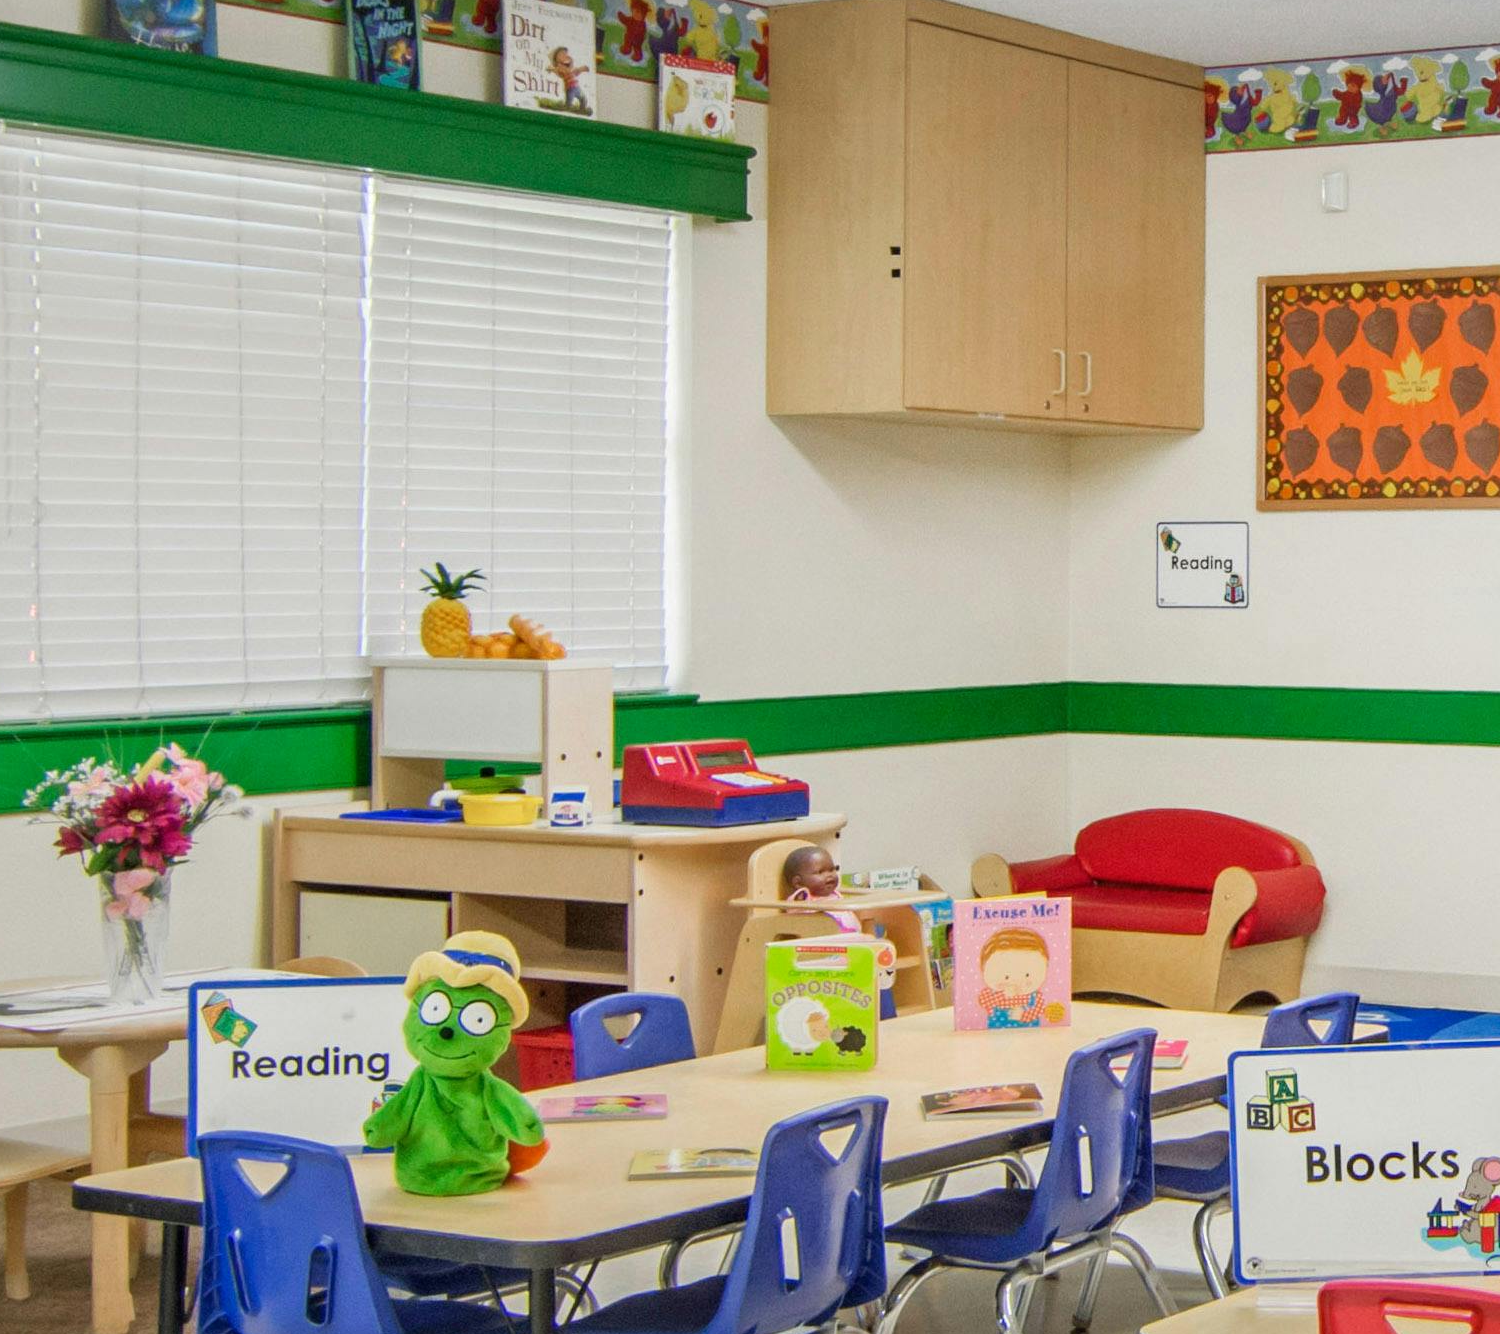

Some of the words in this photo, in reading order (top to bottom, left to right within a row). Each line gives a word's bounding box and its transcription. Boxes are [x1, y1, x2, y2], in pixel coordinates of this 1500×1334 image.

[377, 21, 414, 39] NIGHT
[511, 14, 546, 41] Dirt
[515, 38, 531, 50] on
[525, 52, 544, 71] My
[513, 69, 560, 96] Shirt
[1171, 555, 1233, 573] Reading
[973, 905, 1028, 920] Excuse
[1031, 903, 1060, 917] Me!
[771, 979, 873, 1010] OPPOSITES
[232, 1046, 390, 1082] Reading
[1276, 1079, 1294, 1099] A
[1252, 1108, 1269, 1126] B
[1293, 1109, 1310, 1127] C
[1305, 1140, 1460, 1183] Blocks
